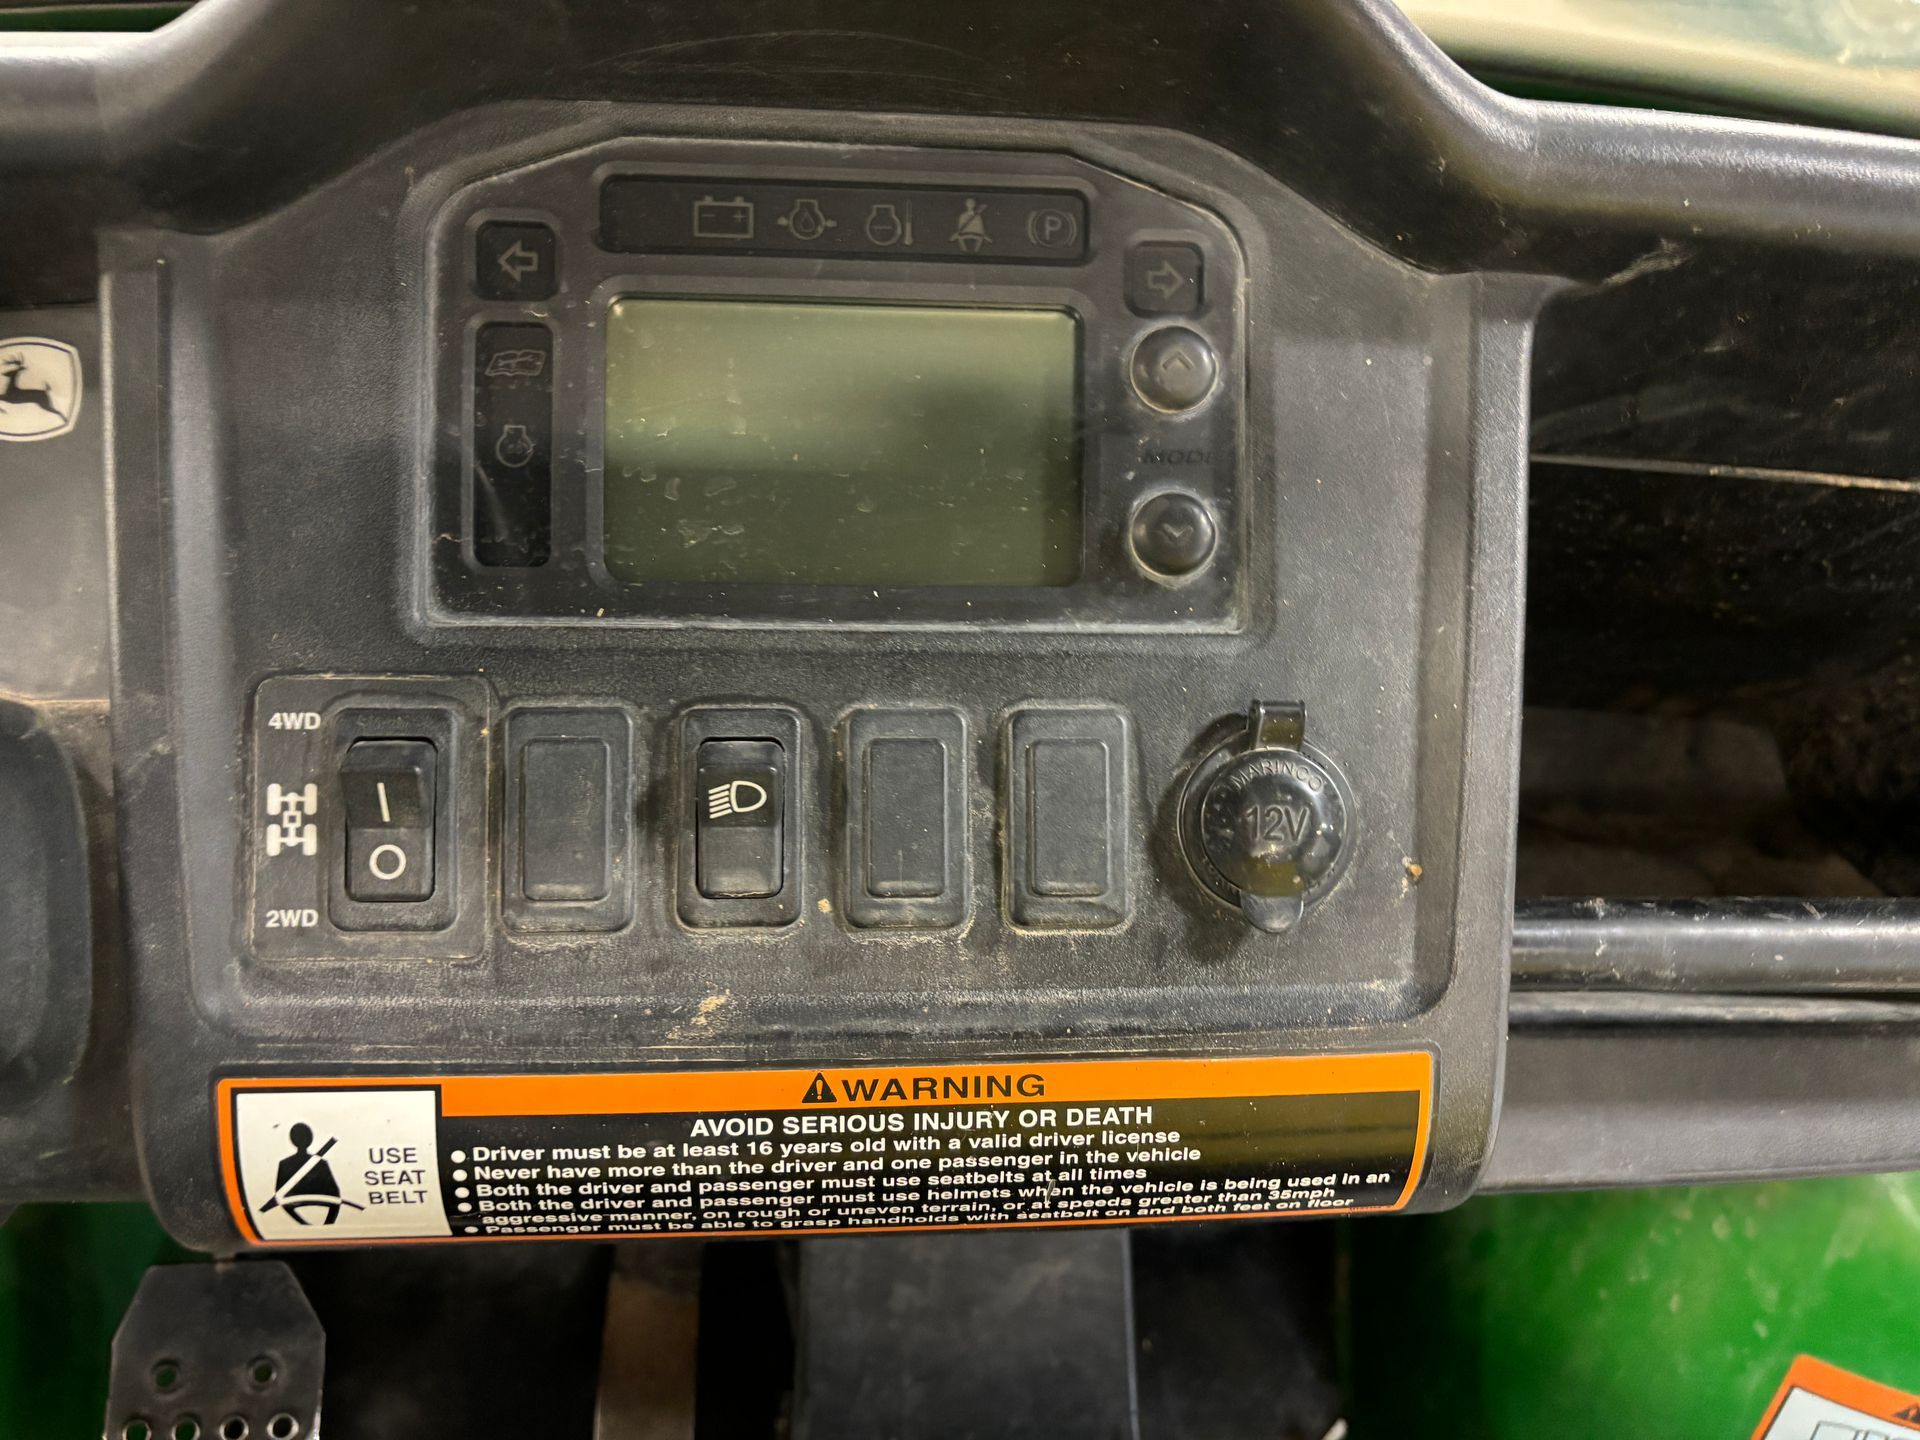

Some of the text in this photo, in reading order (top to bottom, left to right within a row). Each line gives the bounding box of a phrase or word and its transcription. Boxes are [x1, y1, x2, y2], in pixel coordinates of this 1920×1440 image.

[1045, 215, 1062, 241] P
[268, 712, 321, 730] 4WD
[1229, 760, 1324, 793] MARINCO
[1246, 804, 1310, 842] 12V
[265, 909, 318, 928] 2WD
[842, 1074, 1044, 1101] WARNING
[690, 1106, 1152, 1137] AVOID SERIOUS INJURY OR DEATH
[369, 1148, 417, 1163] USE
[473, 1131, 1180, 1161] Driver must be at least 16 years old with a valid driver license
[364, 1170, 425, 1185] SEAT
[474, 1148, 1201, 1180] Never have more than the driver and one passenger in the vehicle
[476, 1168, 1147, 1197] Both the driver and passenger must use seatbelts at all times
[479, 1173, 1390, 1212] Both the driver and passenger must use helmets when the vehicle is being used in an
[369, 1191, 428, 1204] BELT
[482, 1188, 1335, 1225] aggressive manner, on rough or uneven terrain, or at speeds greater than 35mph
[486, 1224, 601, 1234] Passenger
[608, 1222, 661, 1231] must
[668, 1222, 694, 1230] be
[702, 1220, 746, 1229] able
[781, 1218, 841, 1229] grasp
[848, 1215, 959, 1225] handholds
[966, 1213, 1008, 1222] with
[1017, 1210, 1099, 1220] seatbelt
[1137, 1206, 1174, 1216] and
[1181, 1204, 1226, 1214] both
[1233, 1201, 1271, 1211] feet
[1276, 1201, 1300, 1209] on
[1308, 1197, 1353, 1208] floor
